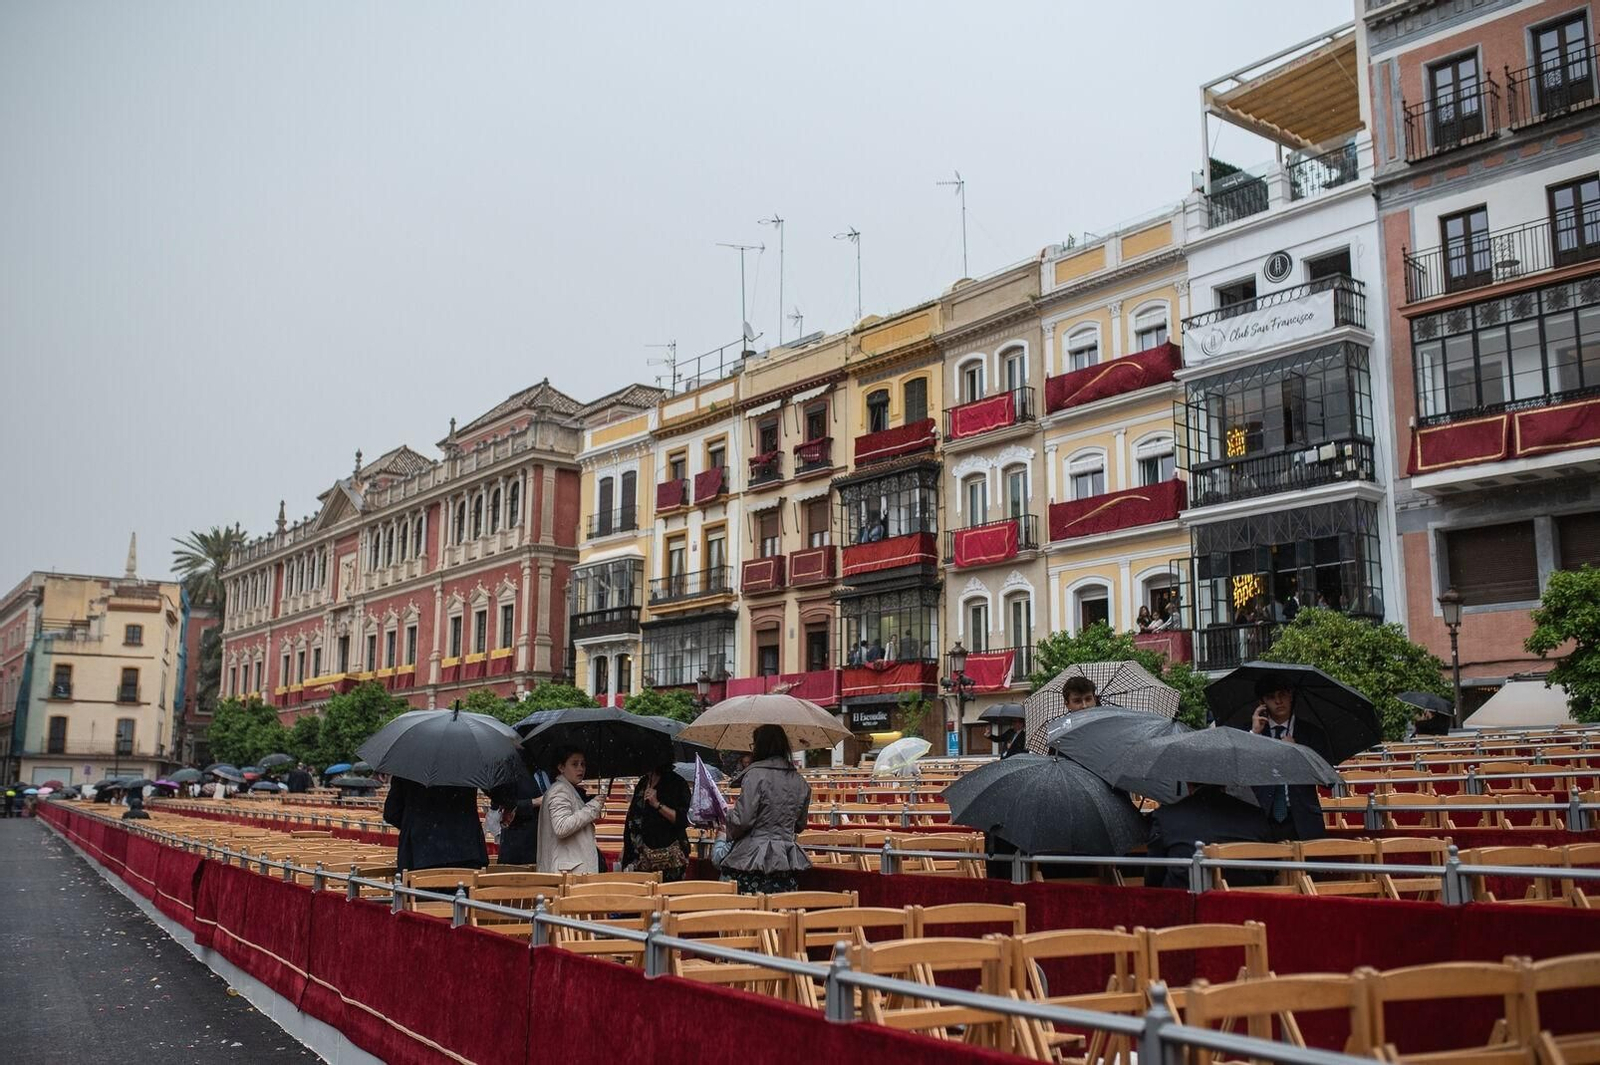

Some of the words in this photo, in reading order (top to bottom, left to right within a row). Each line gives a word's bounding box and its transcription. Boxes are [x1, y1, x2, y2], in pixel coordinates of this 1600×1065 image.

[1229, 326, 1249, 343] Club
[1251, 323, 1269, 337] San
[1270, 312, 1314, 329] Francisco
